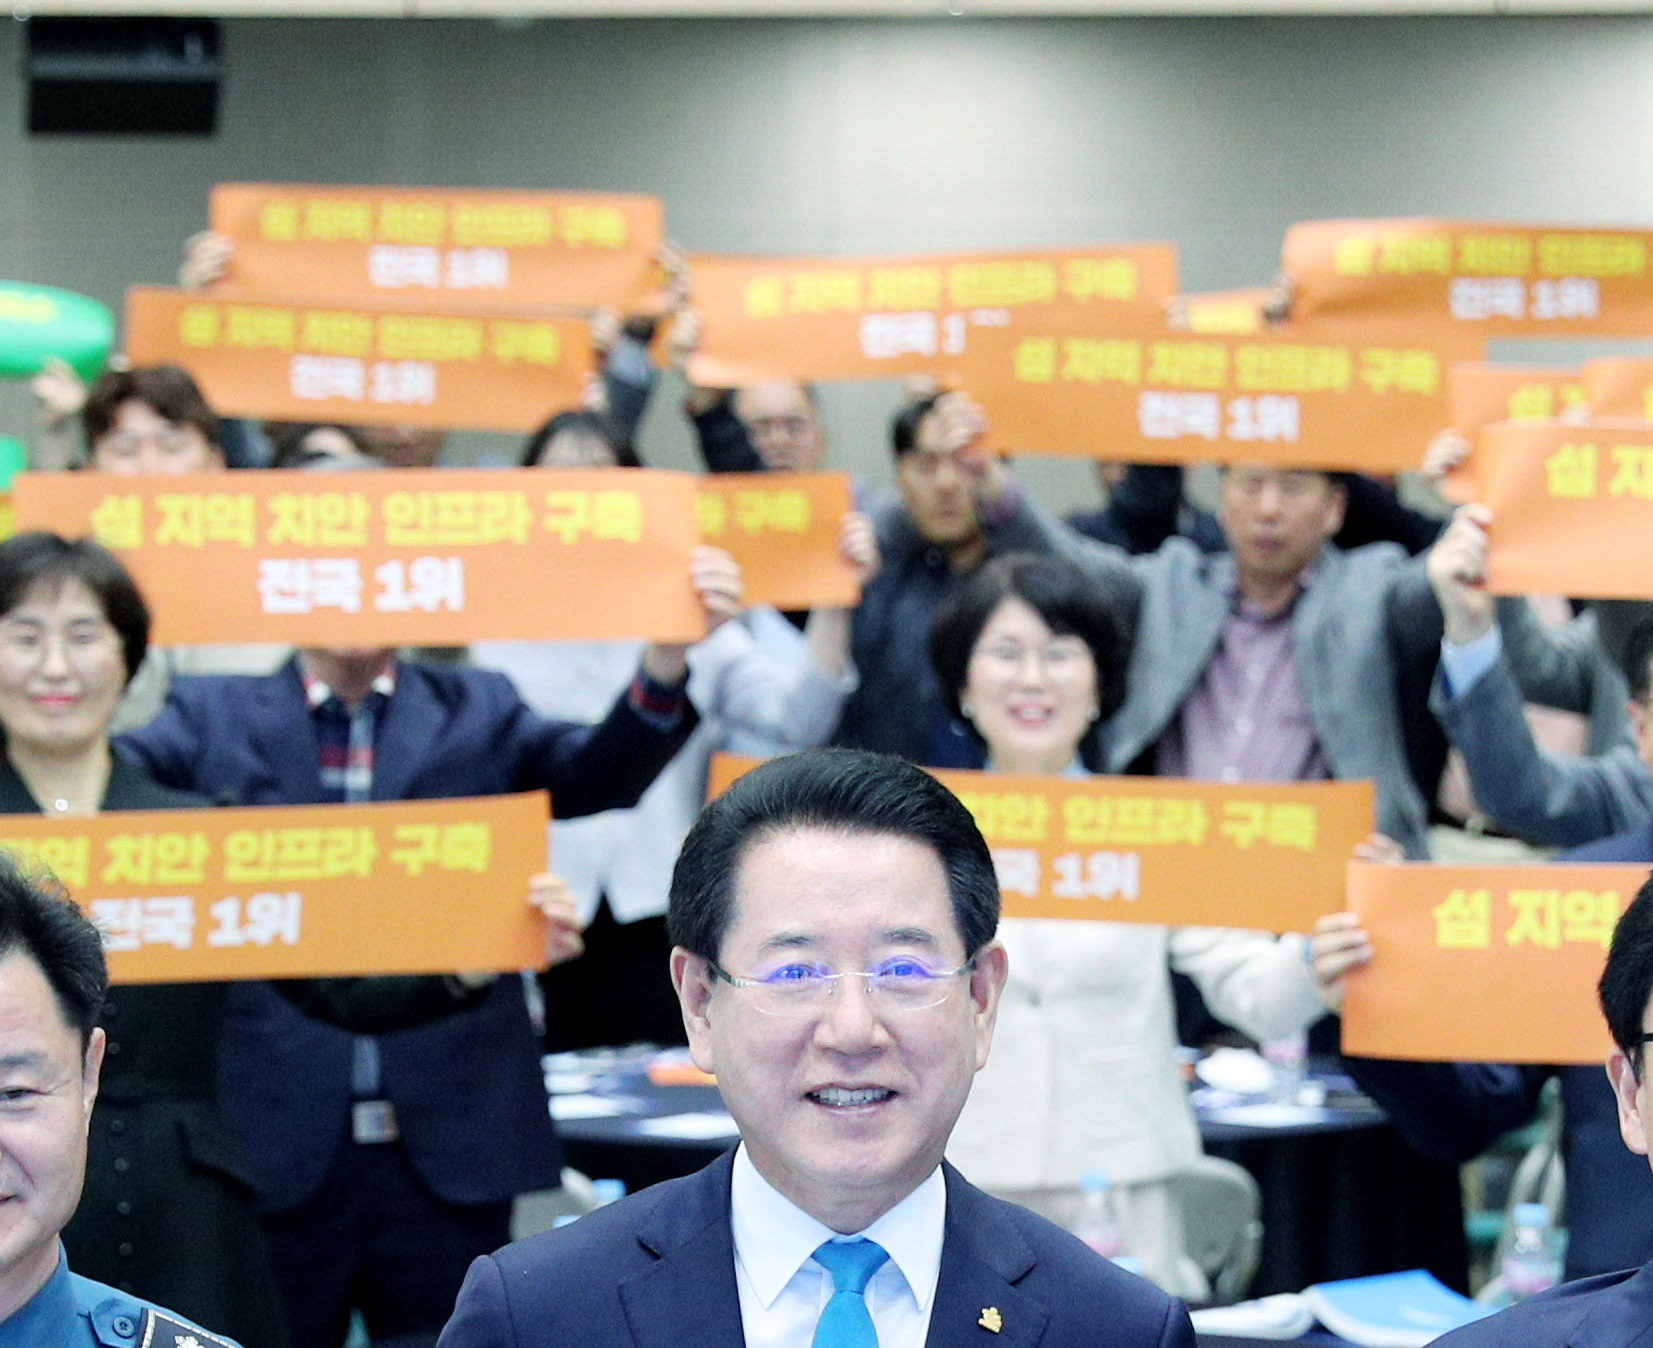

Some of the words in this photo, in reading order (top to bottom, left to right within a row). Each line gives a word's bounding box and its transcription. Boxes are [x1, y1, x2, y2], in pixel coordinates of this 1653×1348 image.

[155, 493, 255, 548] 지역
[267, 492, 370, 548] 치안
[382, 491, 533, 547] 인프라
[544, 490, 644, 545] 구축
[257, 556, 363, 614] 전국
[374, 556, 465, 613] 1위
[102, 831, 210, 885] 치안
[223, 827, 378, 881] 인프라
[390, 822, 494, 875] 구축
[208, 891, 305, 949] 1위
[1432, 889, 1492, 949] 섬
